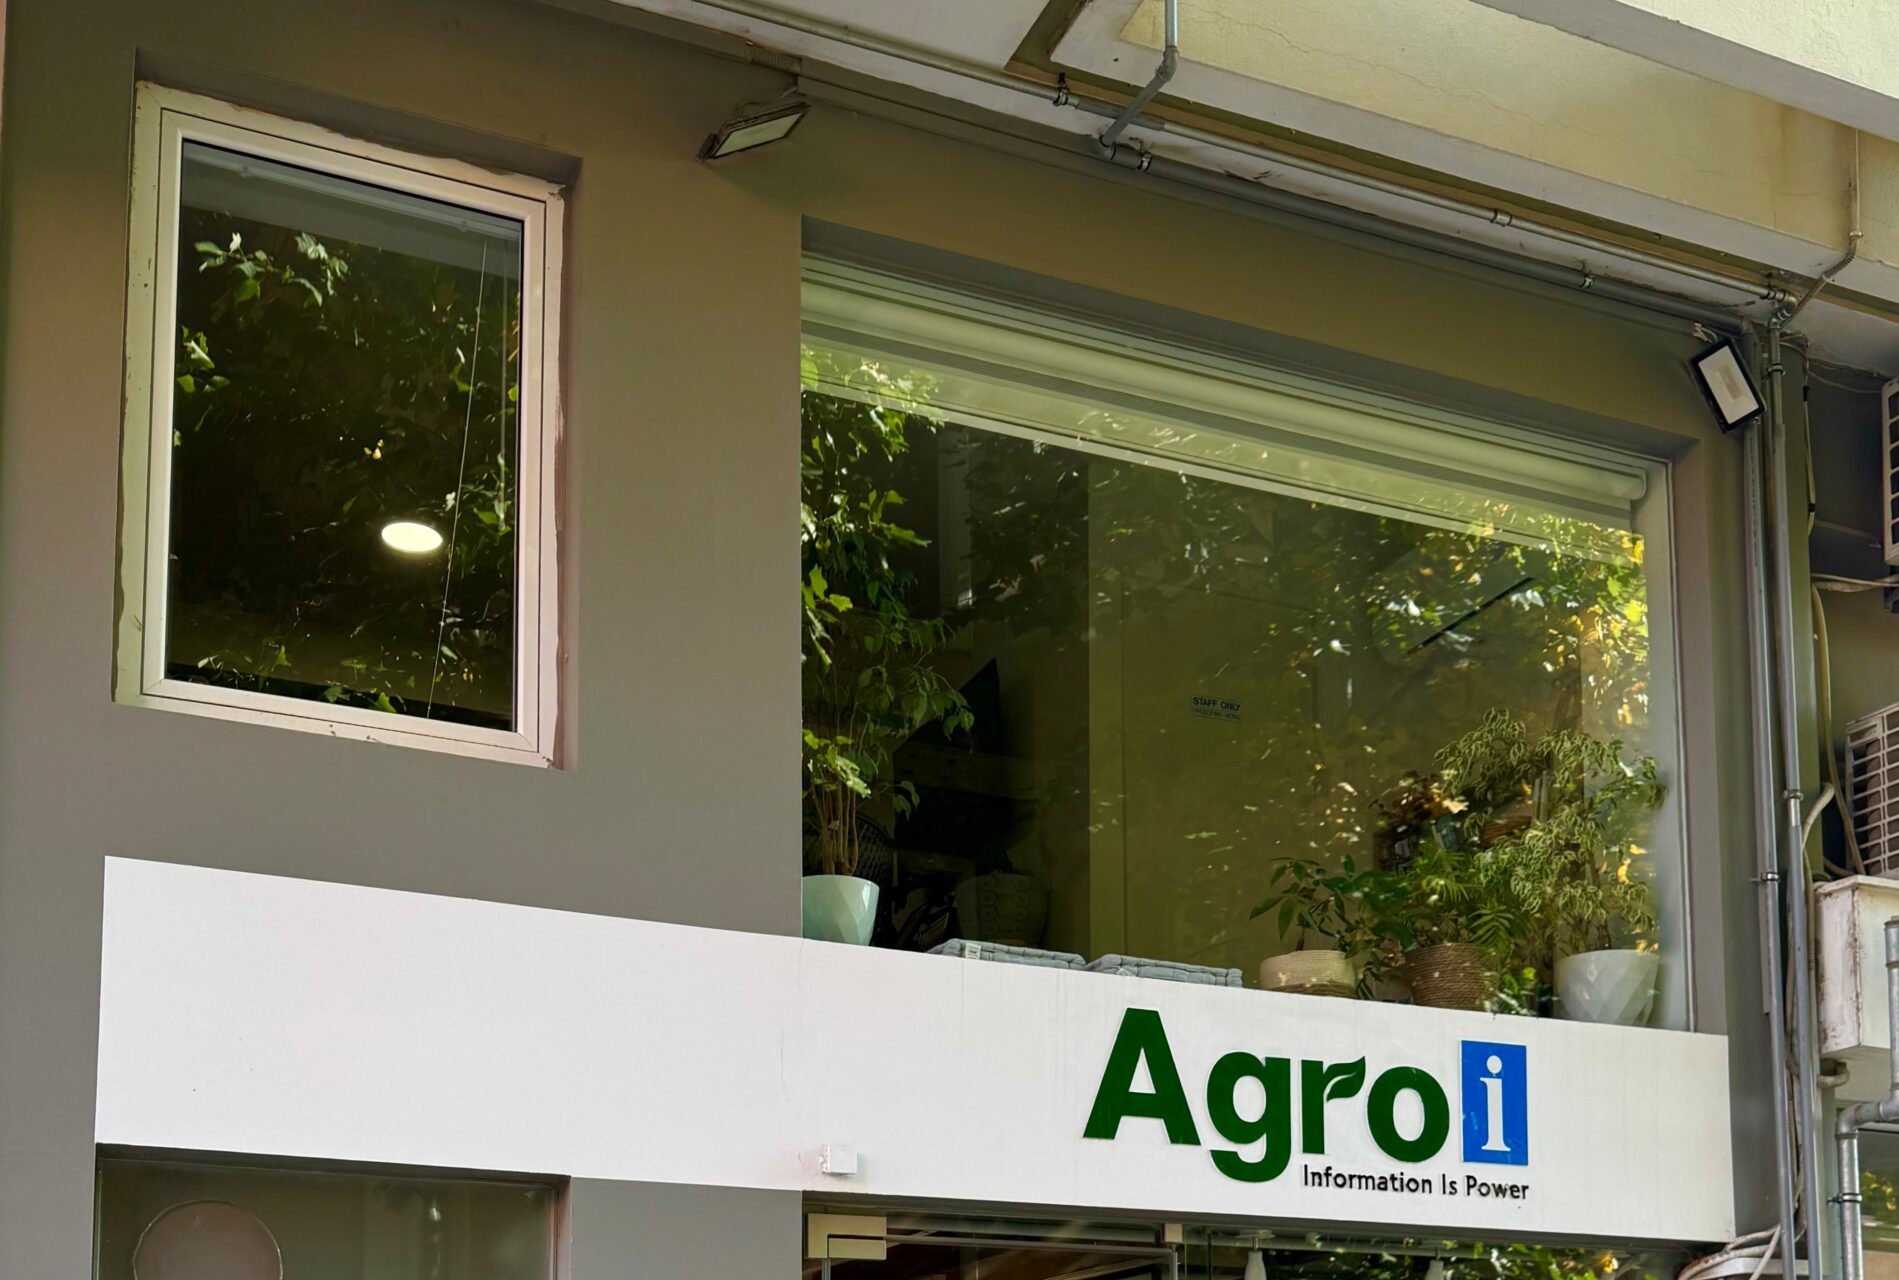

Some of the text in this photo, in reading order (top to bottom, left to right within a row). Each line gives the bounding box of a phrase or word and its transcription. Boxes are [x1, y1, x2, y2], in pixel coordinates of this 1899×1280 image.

[1193, 697, 1241, 711] STAFF ONLY
[1303, 1165, 1530, 1200] Information Is Power
